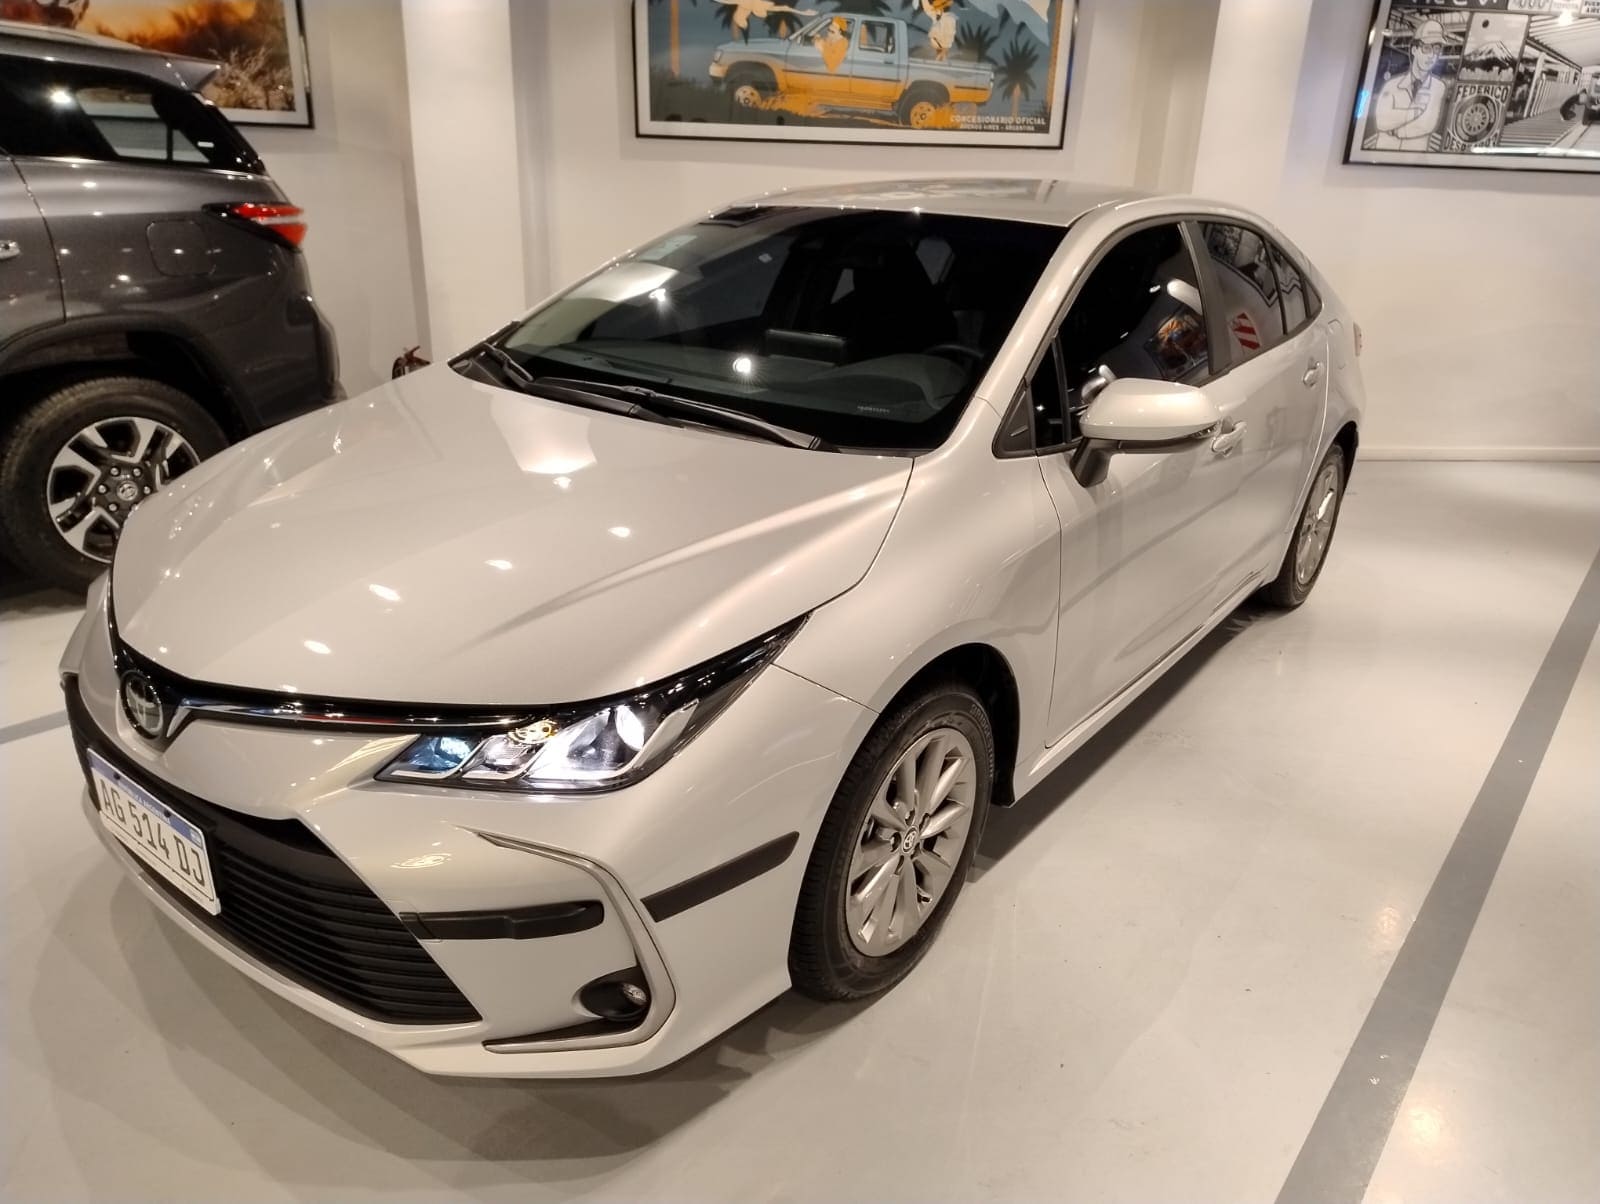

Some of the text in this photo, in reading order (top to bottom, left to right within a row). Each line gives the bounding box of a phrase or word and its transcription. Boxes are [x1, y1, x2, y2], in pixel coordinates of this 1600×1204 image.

[1456, 85, 1509, 103] FEDERICO
[950, 114, 1047, 126] CONCESIONARIO OFICIAL
[100, 778, 126, 825] AG
[128, 800, 170, 860] 514
[173, 834, 206, 887] DJ
